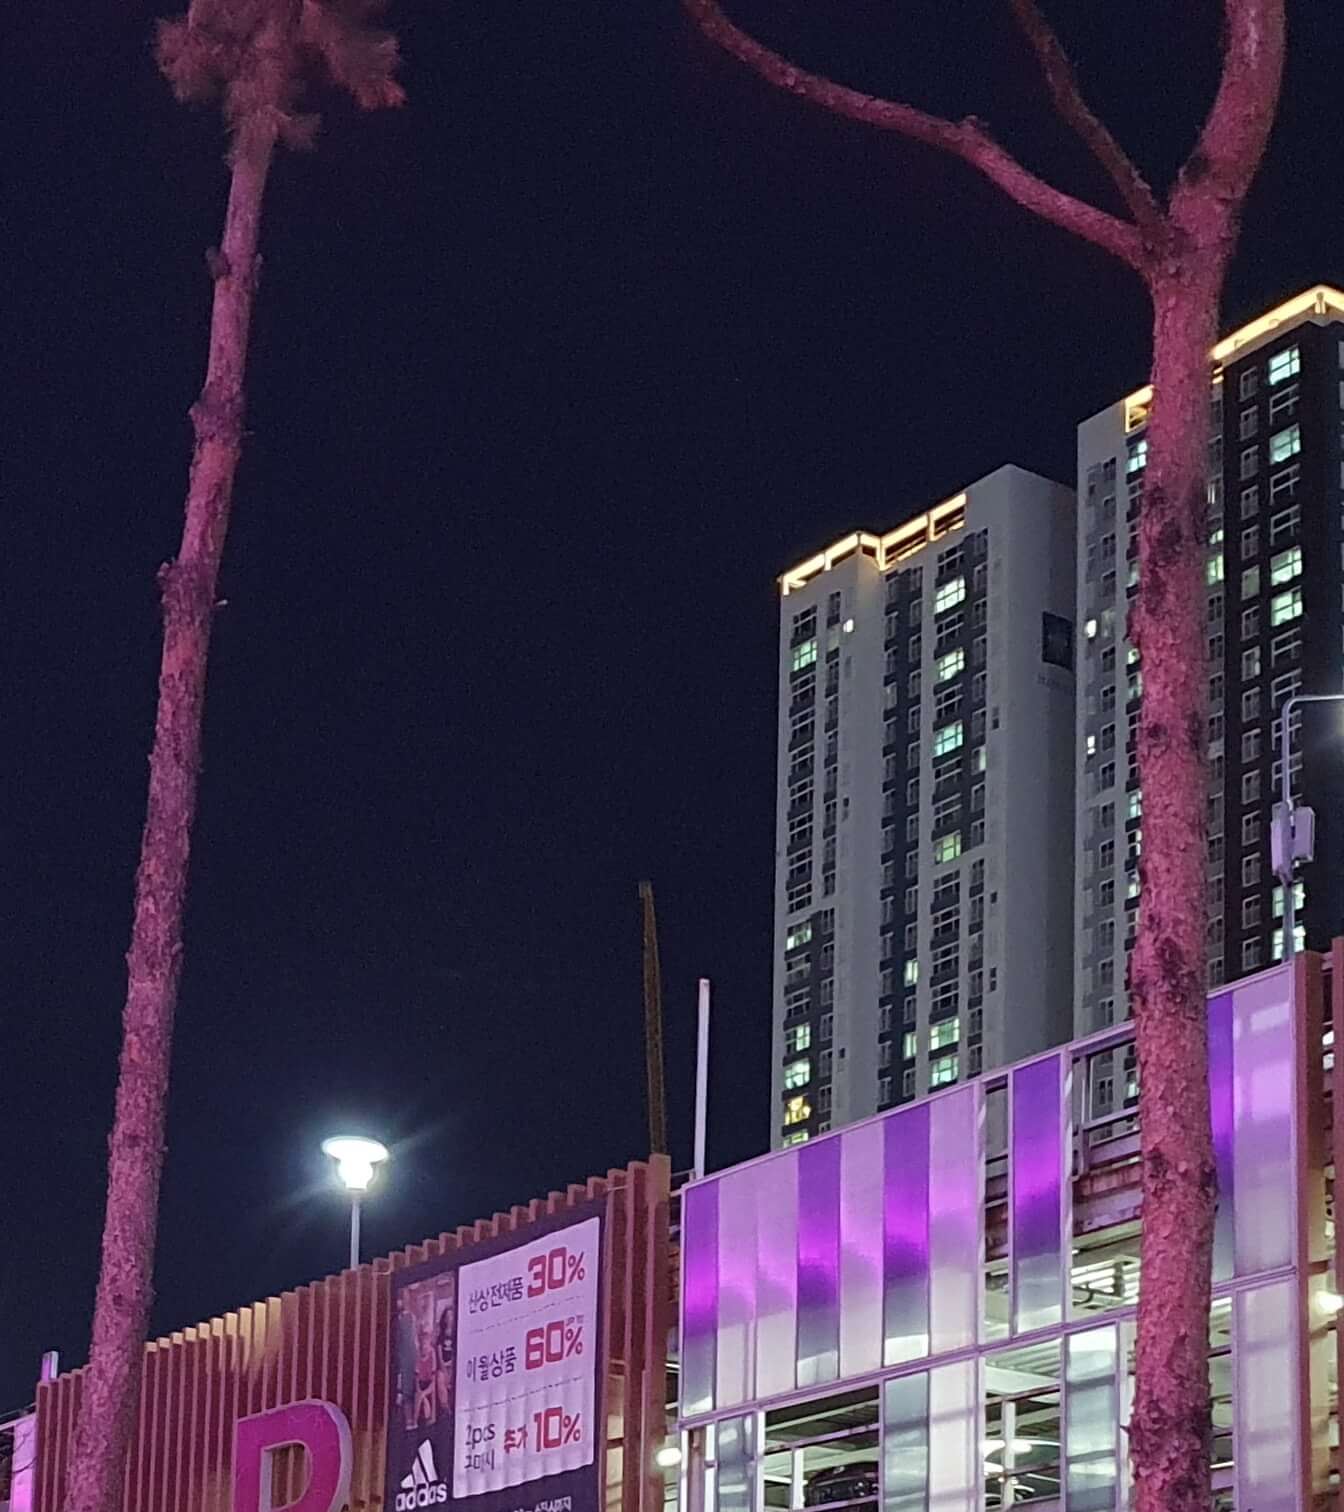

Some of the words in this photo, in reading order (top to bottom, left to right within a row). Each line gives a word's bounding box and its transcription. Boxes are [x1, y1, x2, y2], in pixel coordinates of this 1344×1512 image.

[527, 1246, 585, 1298] 30%
[525, 1319, 584, 1370] 60%
[534, 1406, 581, 1452] 10%
